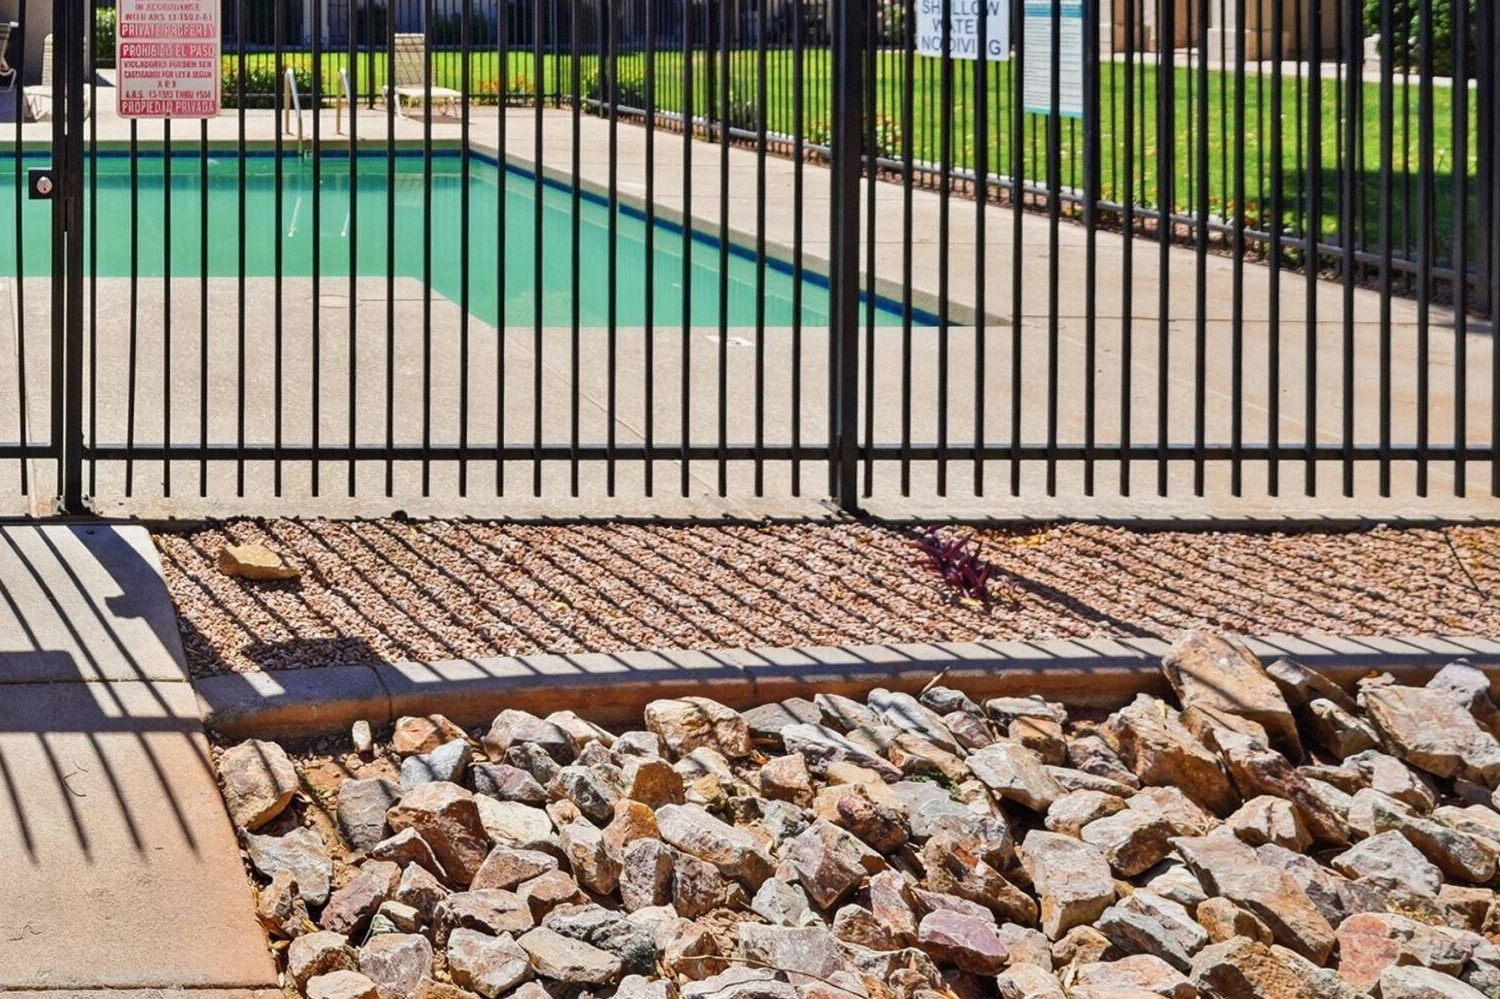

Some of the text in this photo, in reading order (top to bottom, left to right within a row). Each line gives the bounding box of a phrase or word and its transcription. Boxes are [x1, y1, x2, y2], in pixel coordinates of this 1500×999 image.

[922, 0, 1000, 16] SHLLOW
[175, 44, 186, 57] EL
[190, 44, 215, 57] PASO
[175, 101, 214, 113] PRIVADA
